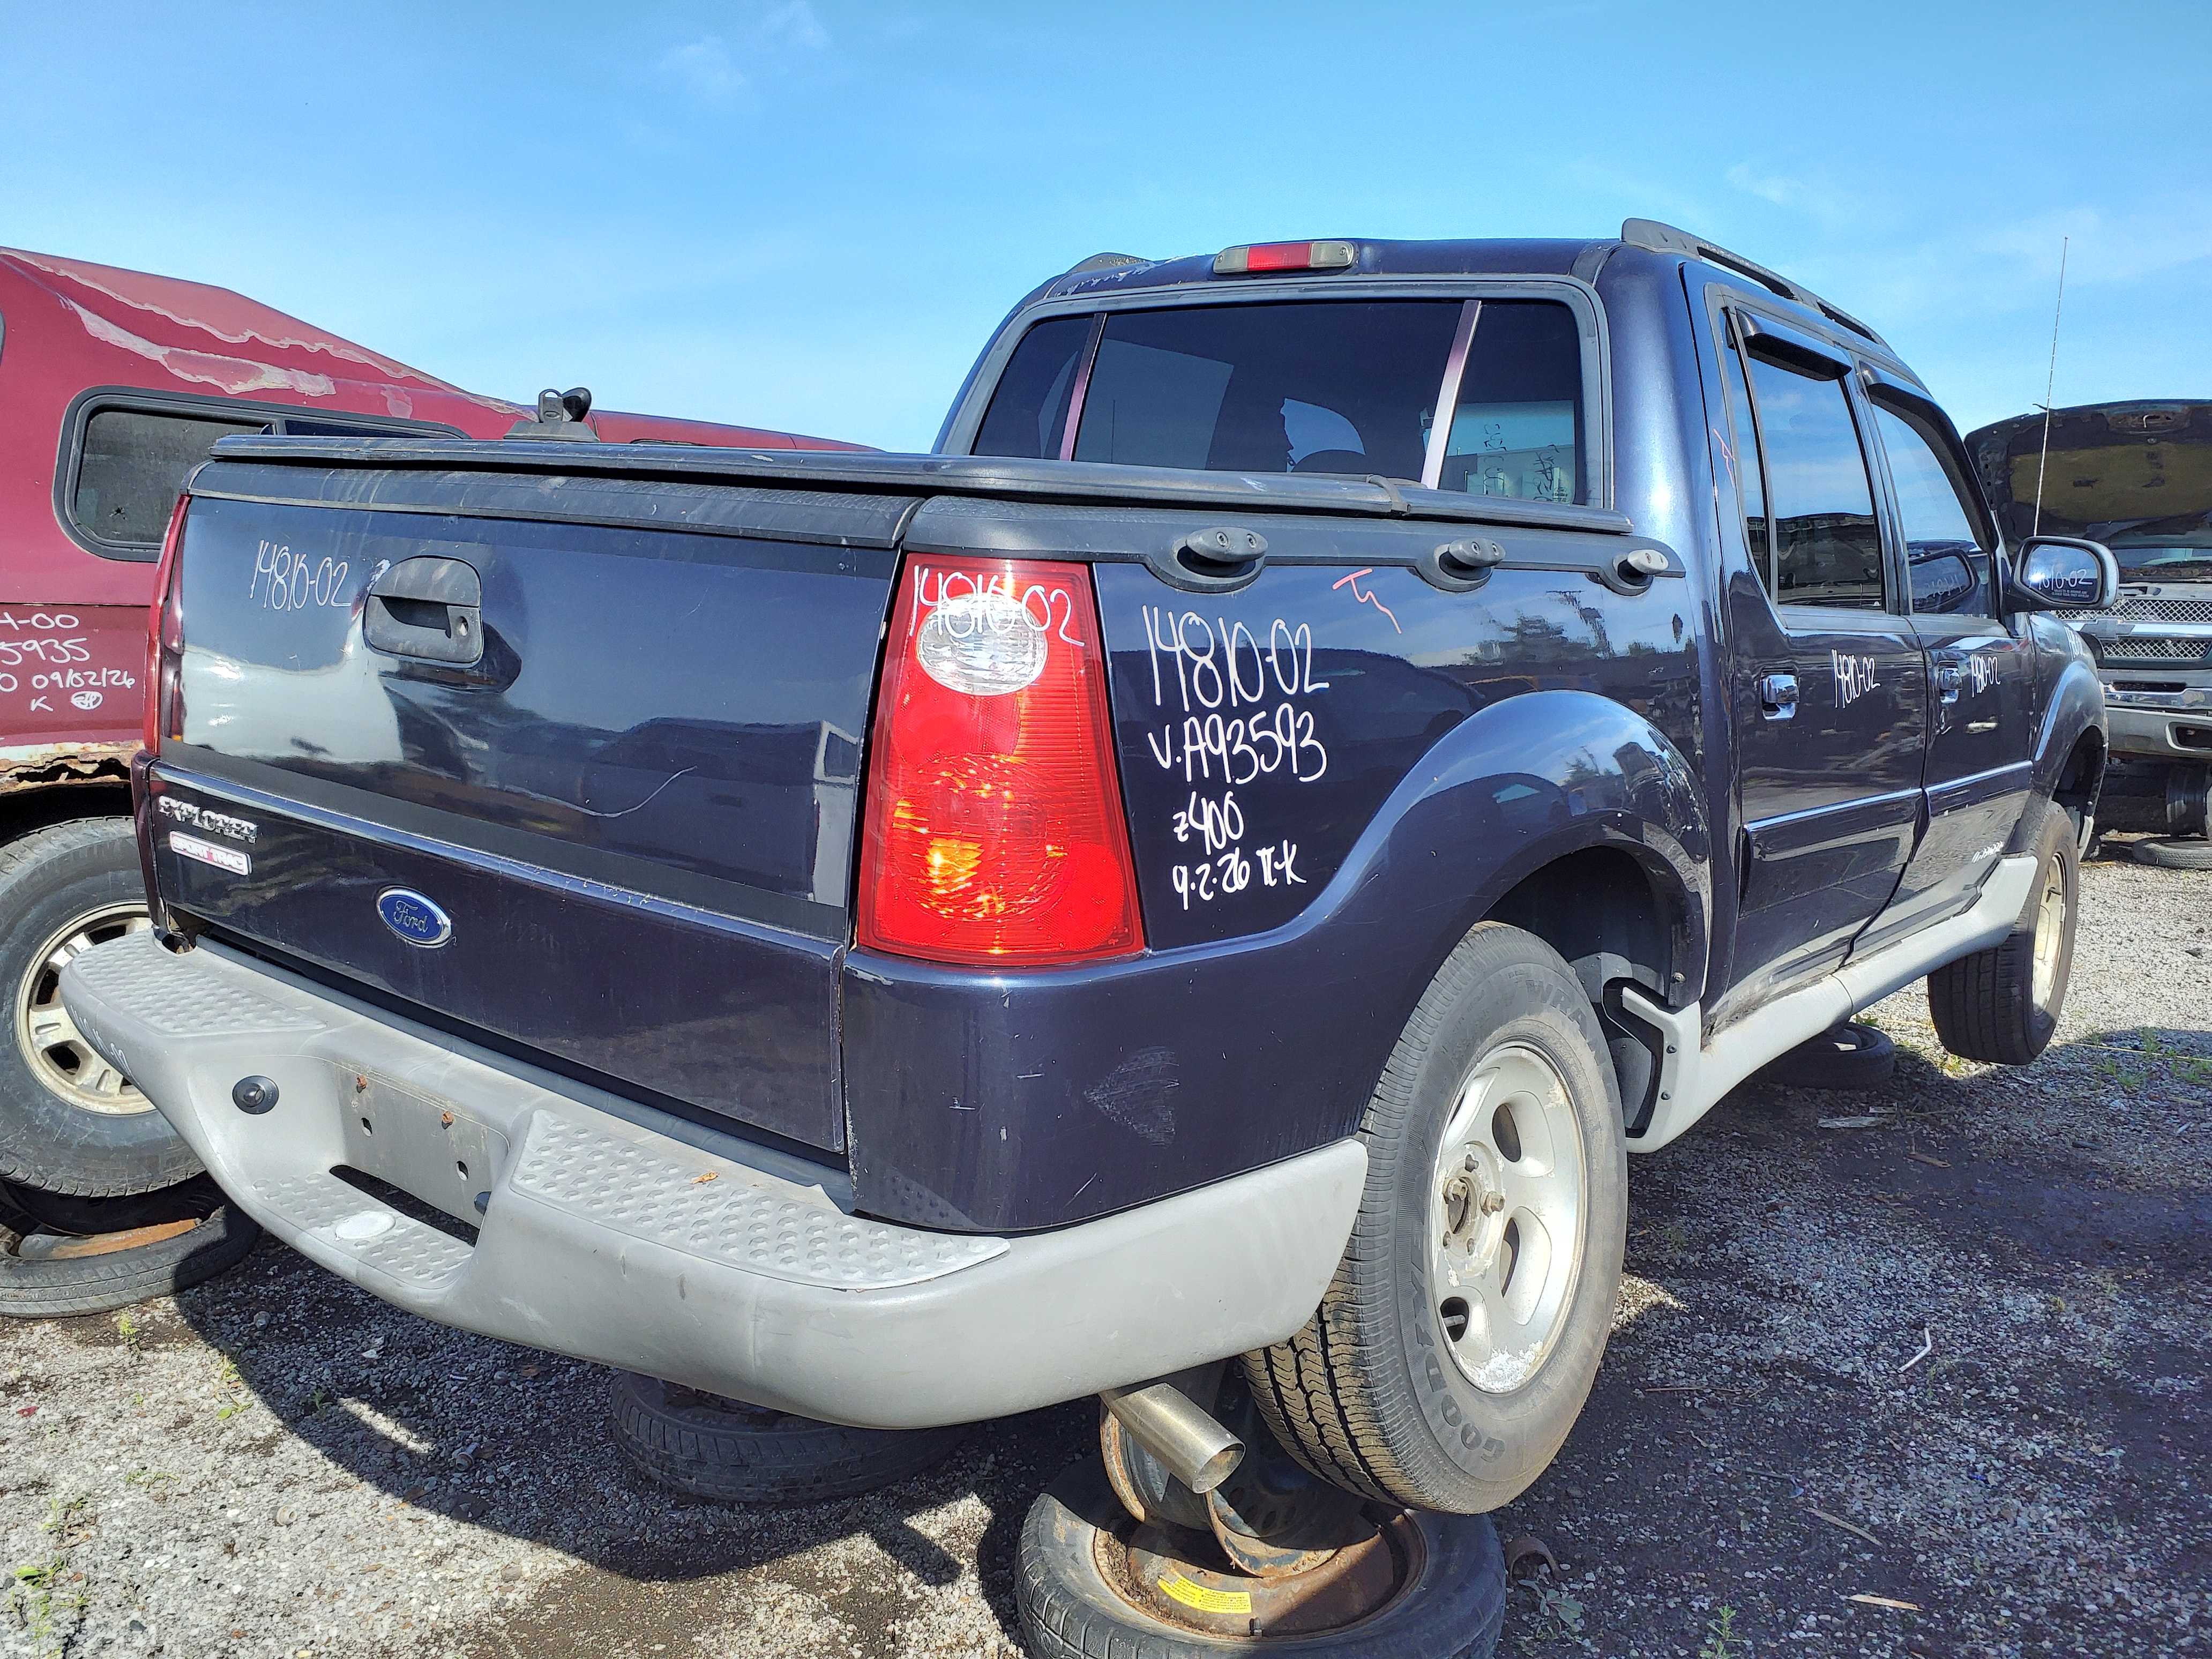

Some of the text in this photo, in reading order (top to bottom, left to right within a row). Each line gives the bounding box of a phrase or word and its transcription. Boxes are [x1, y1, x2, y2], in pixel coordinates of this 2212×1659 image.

[250, 540, 352, 611] 14810-02
[1142, 604, 1330, 712] 14810-02
[159, 796, 259, 844] EXPLORER
[172, 835, 245, 871] SPORT TRAC
[393, 900, 429, 932] Ford
